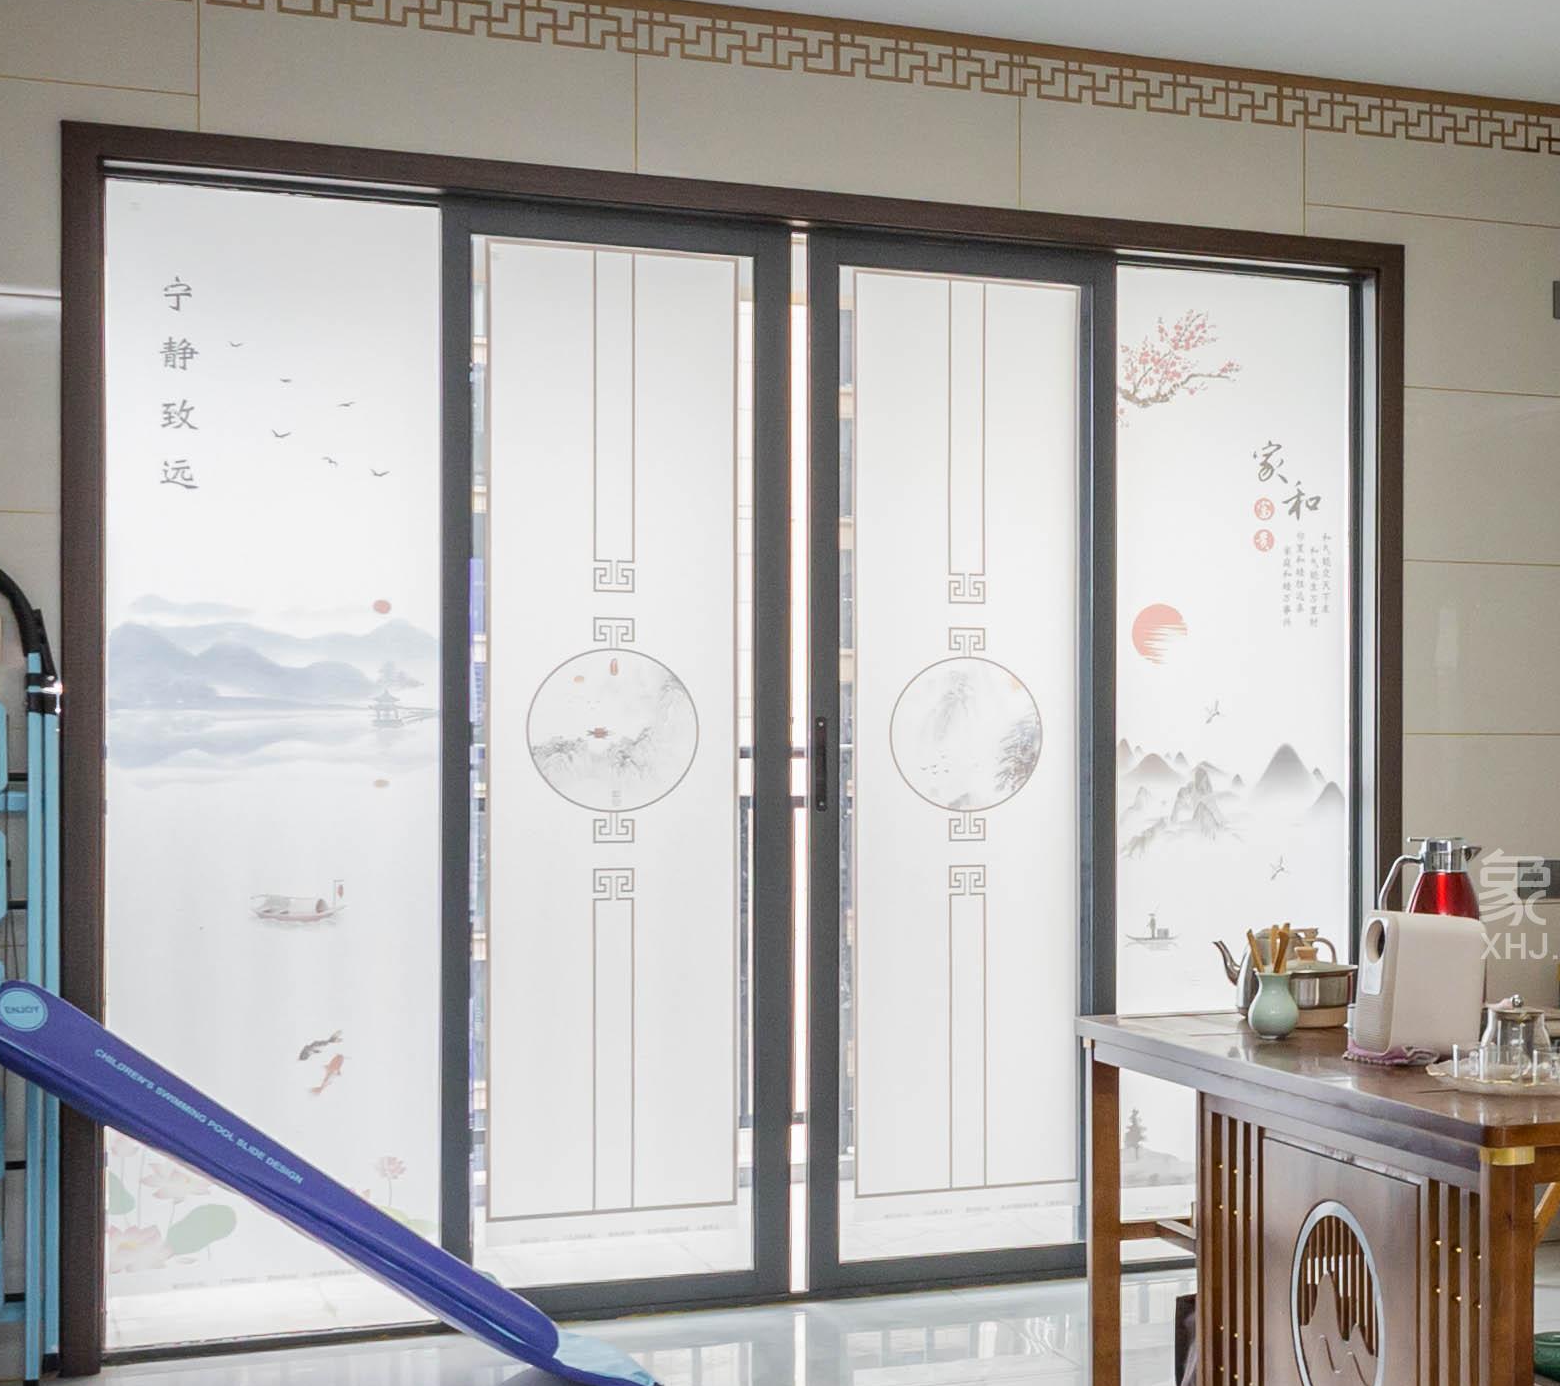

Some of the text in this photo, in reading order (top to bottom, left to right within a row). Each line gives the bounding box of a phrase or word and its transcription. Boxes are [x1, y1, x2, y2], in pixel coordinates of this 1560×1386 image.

[158, 274, 200, 490] 宁静致远
[95, 1048, 304, 1185] CHILDREN'S SWIMMING POOL SLIDE DESIGN
